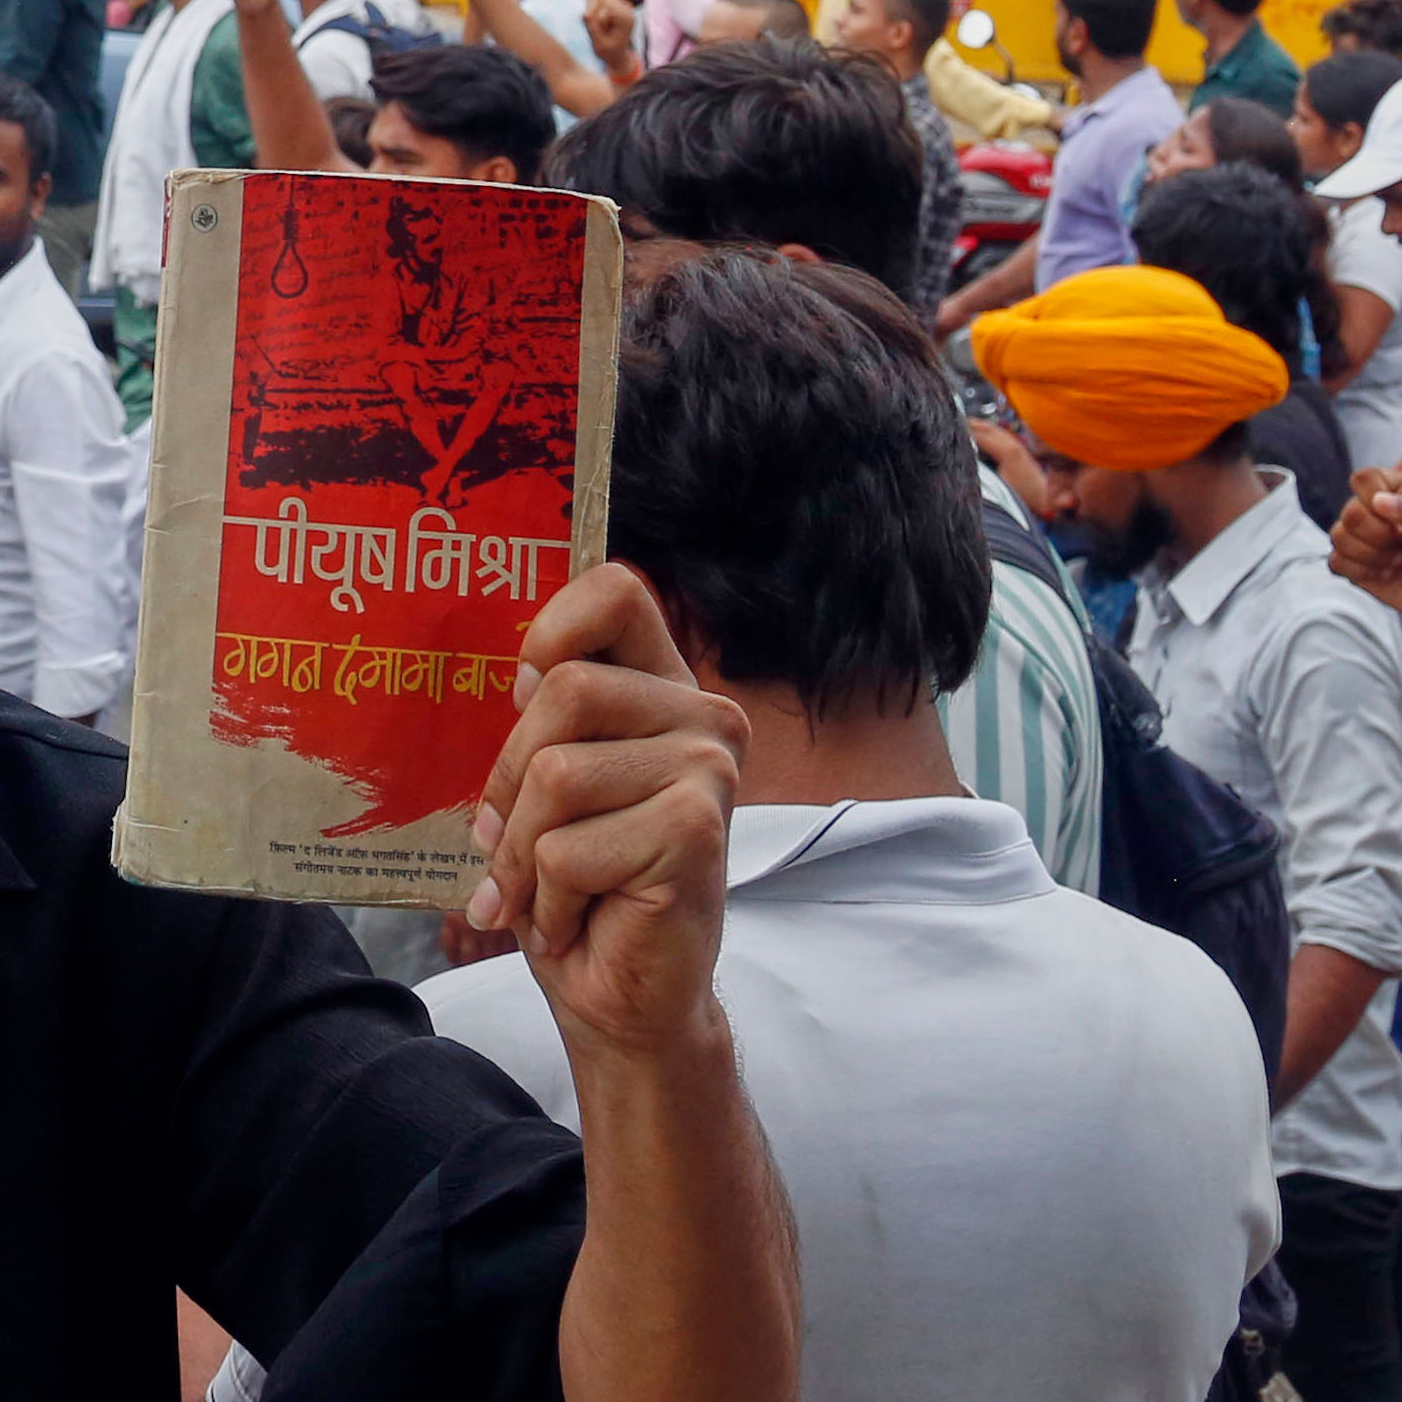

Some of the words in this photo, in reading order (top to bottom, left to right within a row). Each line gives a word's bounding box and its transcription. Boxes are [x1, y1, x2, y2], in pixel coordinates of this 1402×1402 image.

[223, 496, 396, 614] पीयूष
[404, 506, 572, 602] मिश्रा
[216, 631, 330, 693] गगन
[337, 865, 363, 877] नाटक
[365, 866, 379, 877] का
[417, 849, 428, 862] के
[430, 850, 456, 864] लेखन
